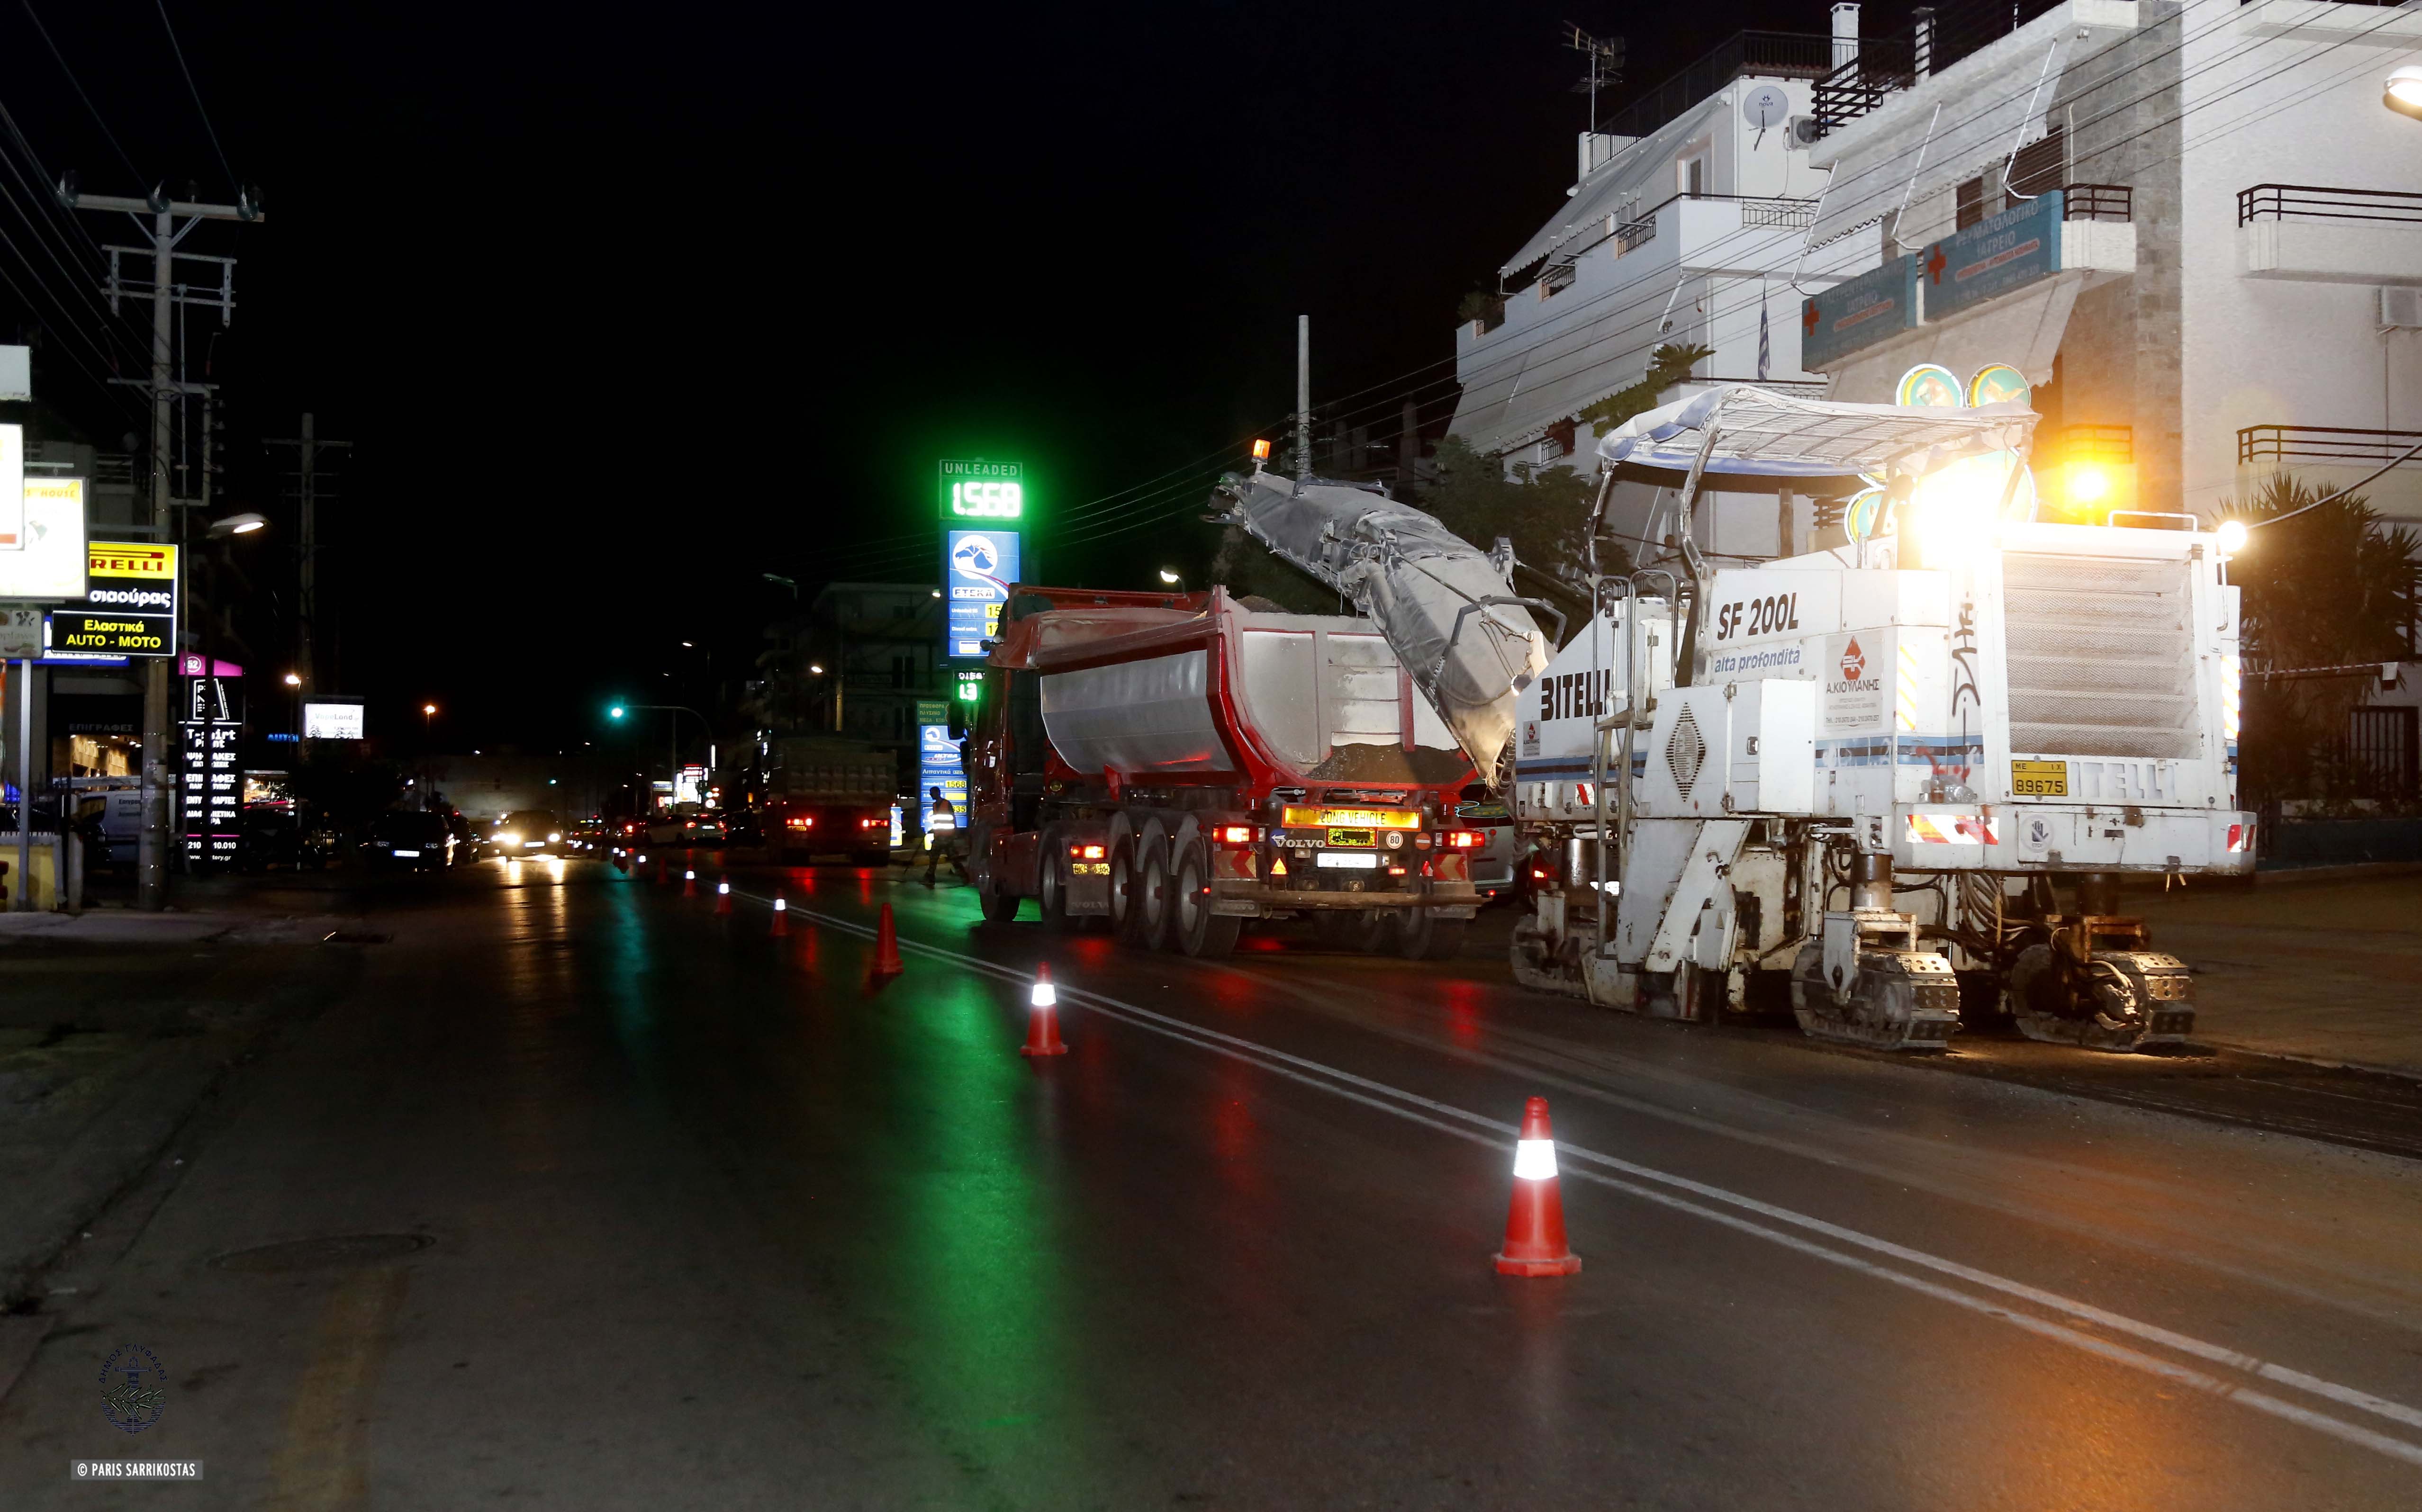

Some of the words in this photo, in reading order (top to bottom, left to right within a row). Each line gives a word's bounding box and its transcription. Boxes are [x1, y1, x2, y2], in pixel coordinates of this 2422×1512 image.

[1977, 231, 2016, 259] ΙΑΤΡΕΙΟ
[945, 463, 1017, 476] UNLEADED
[953, 482, 1020, 517] 1.568
[90, 558, 163, 571] RELLI
[90, 588, 171, 608] σιαούρας
[1717, 602, 1744, 640] SF
[1748, 593, 1798, 636] 200L
[84, 620, 144, 633] Ελαστικά
[66, 634, 106, 647] AUTO
[119, 636, 161, 648] MOTO
[1715, 657, 1736, 673] alta
[1738, 645, 1800, 673] profondità
[69, 723, 133, 732] ΕΠΙΓΡΑΦΕΣ
[2016, 780, 2063, 793] 89675
[2070, 761, 2176, 799] ITELLI
[1348, 812, 1385, 825] VEHICLE
[1275, 839, 1326, 848] VOLVO
[1390, 836, 1400, 844] 80
